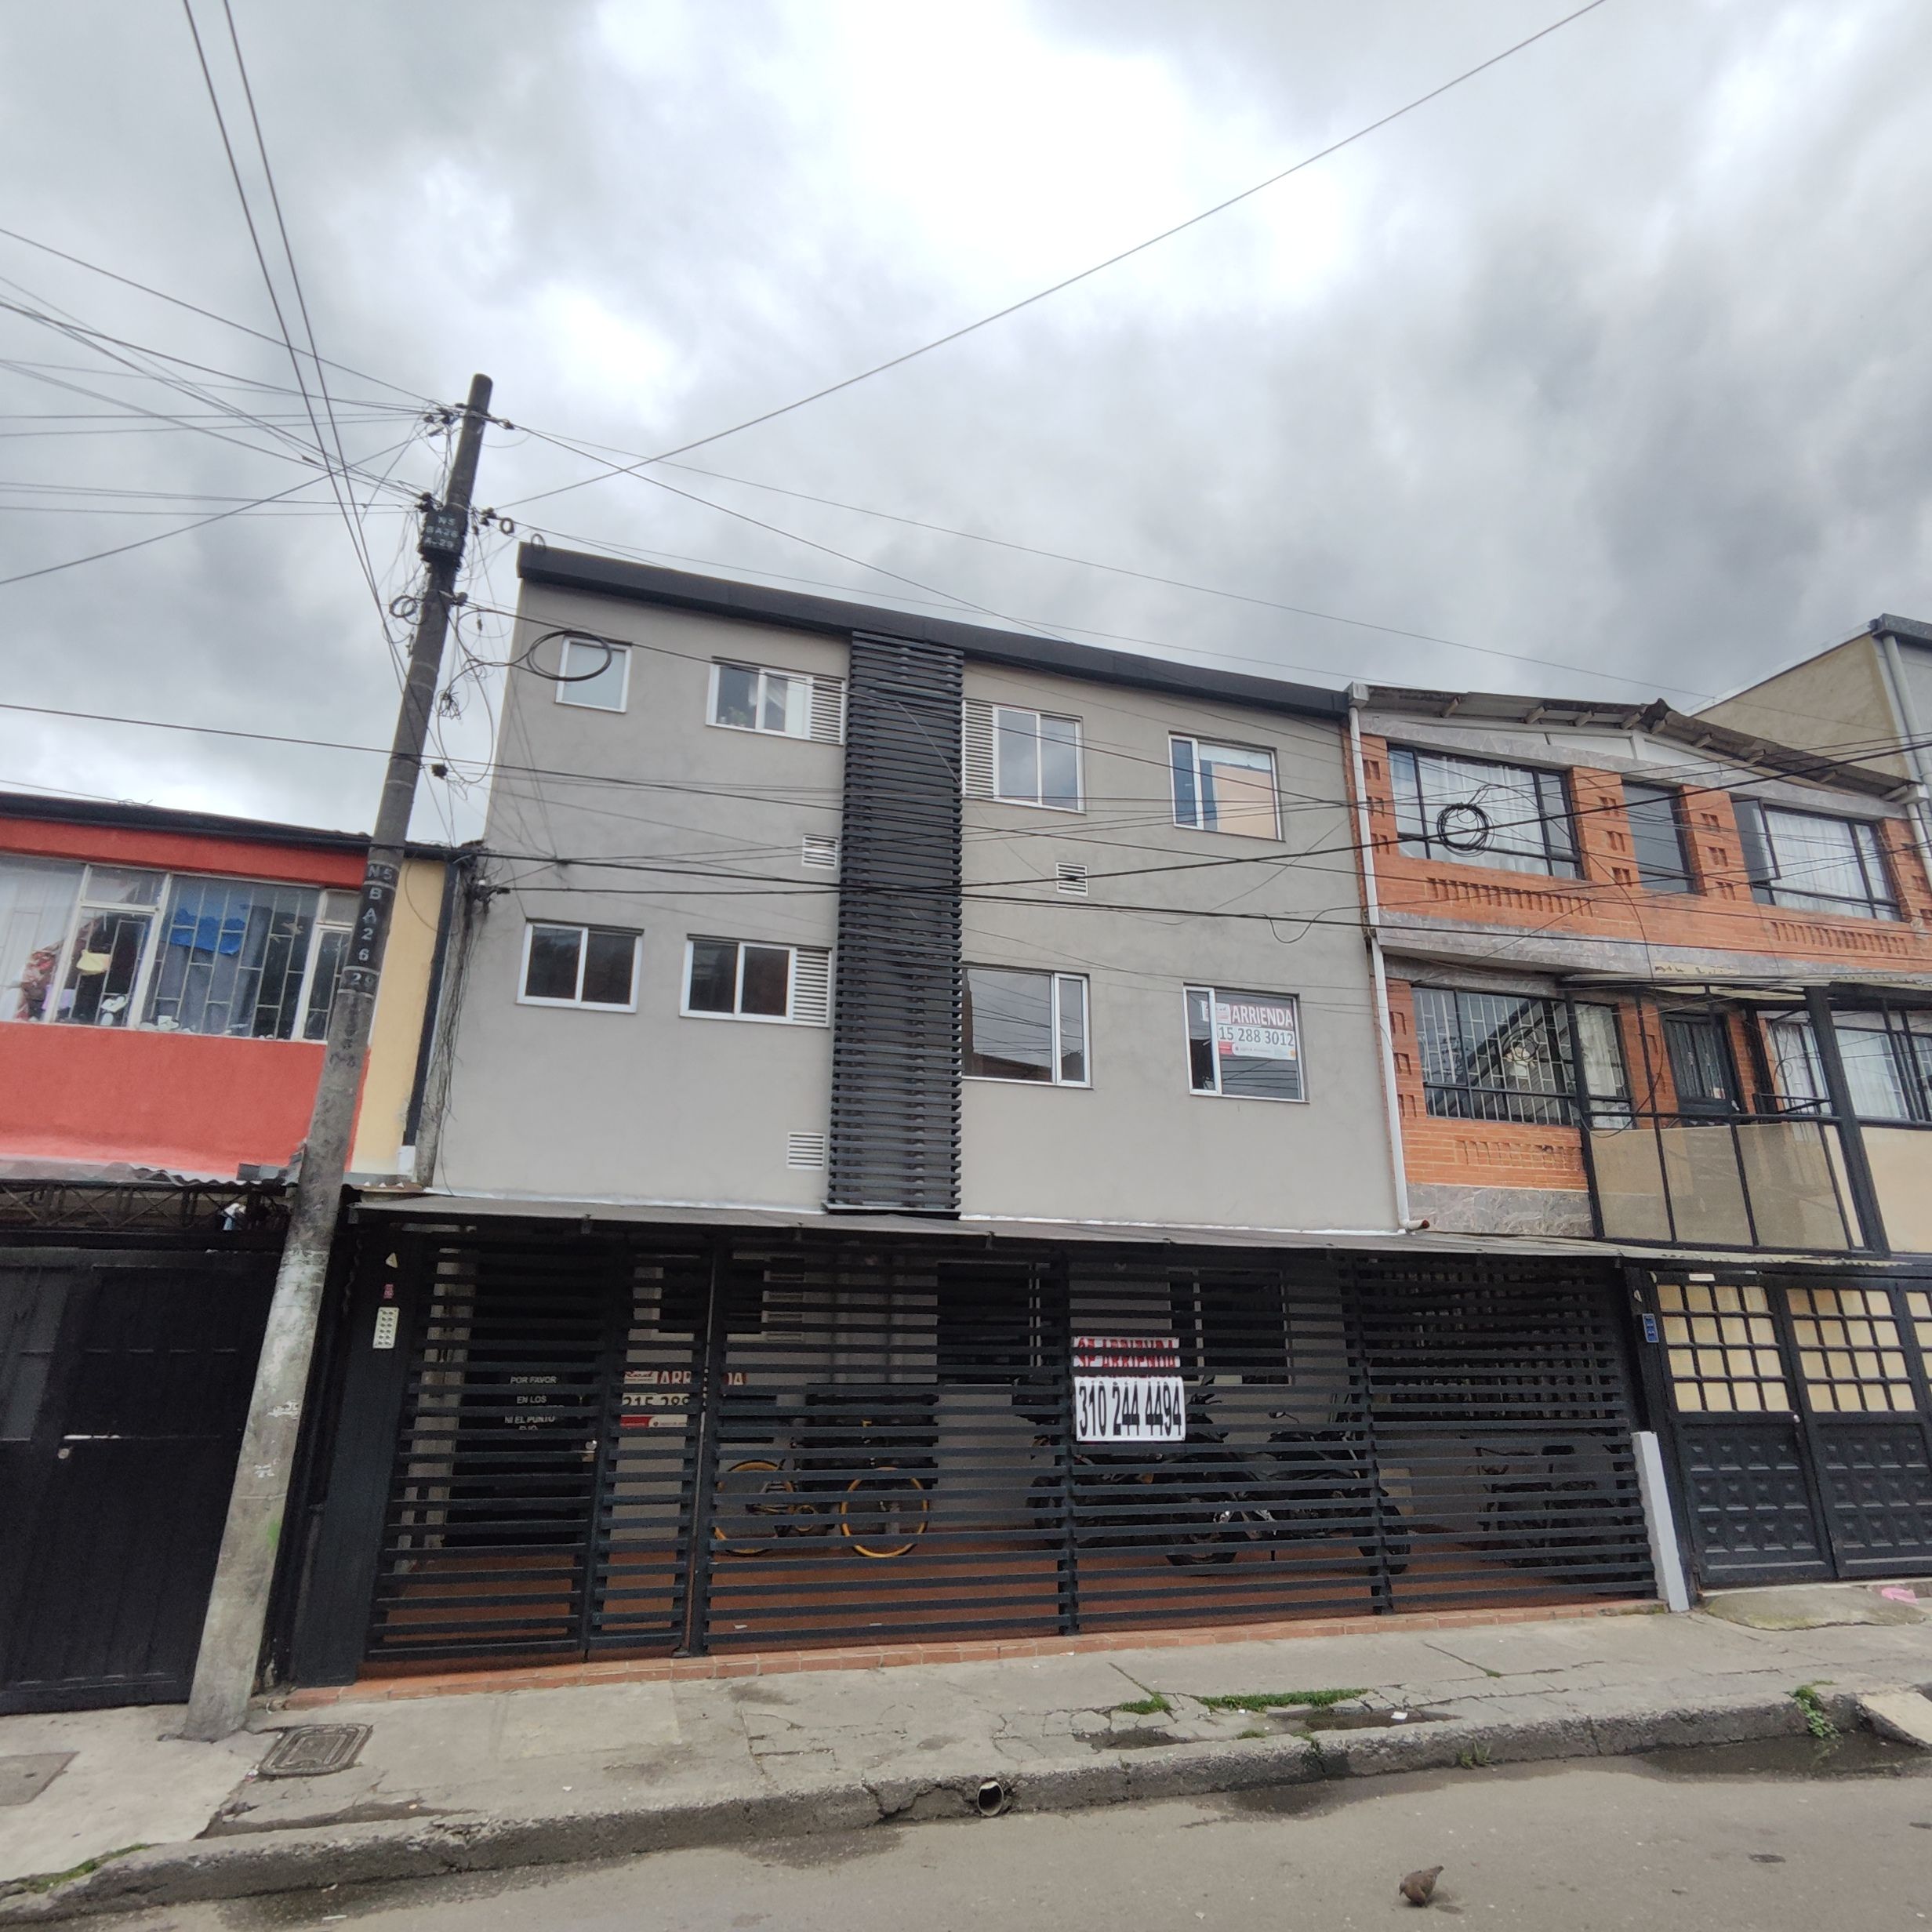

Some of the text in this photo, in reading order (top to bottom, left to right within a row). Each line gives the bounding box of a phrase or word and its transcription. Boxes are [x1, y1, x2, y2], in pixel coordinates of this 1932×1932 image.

[368, 866, 393, 881] N5
[1232, 1005, 1294, 1027] ARRIENDA
[1217, 1026, 1295, 1047] 15 288 3012
[517, 1395, 547, 1404] EN LOS
[1079, 1381, 1182, 1436] 310 244 4494
